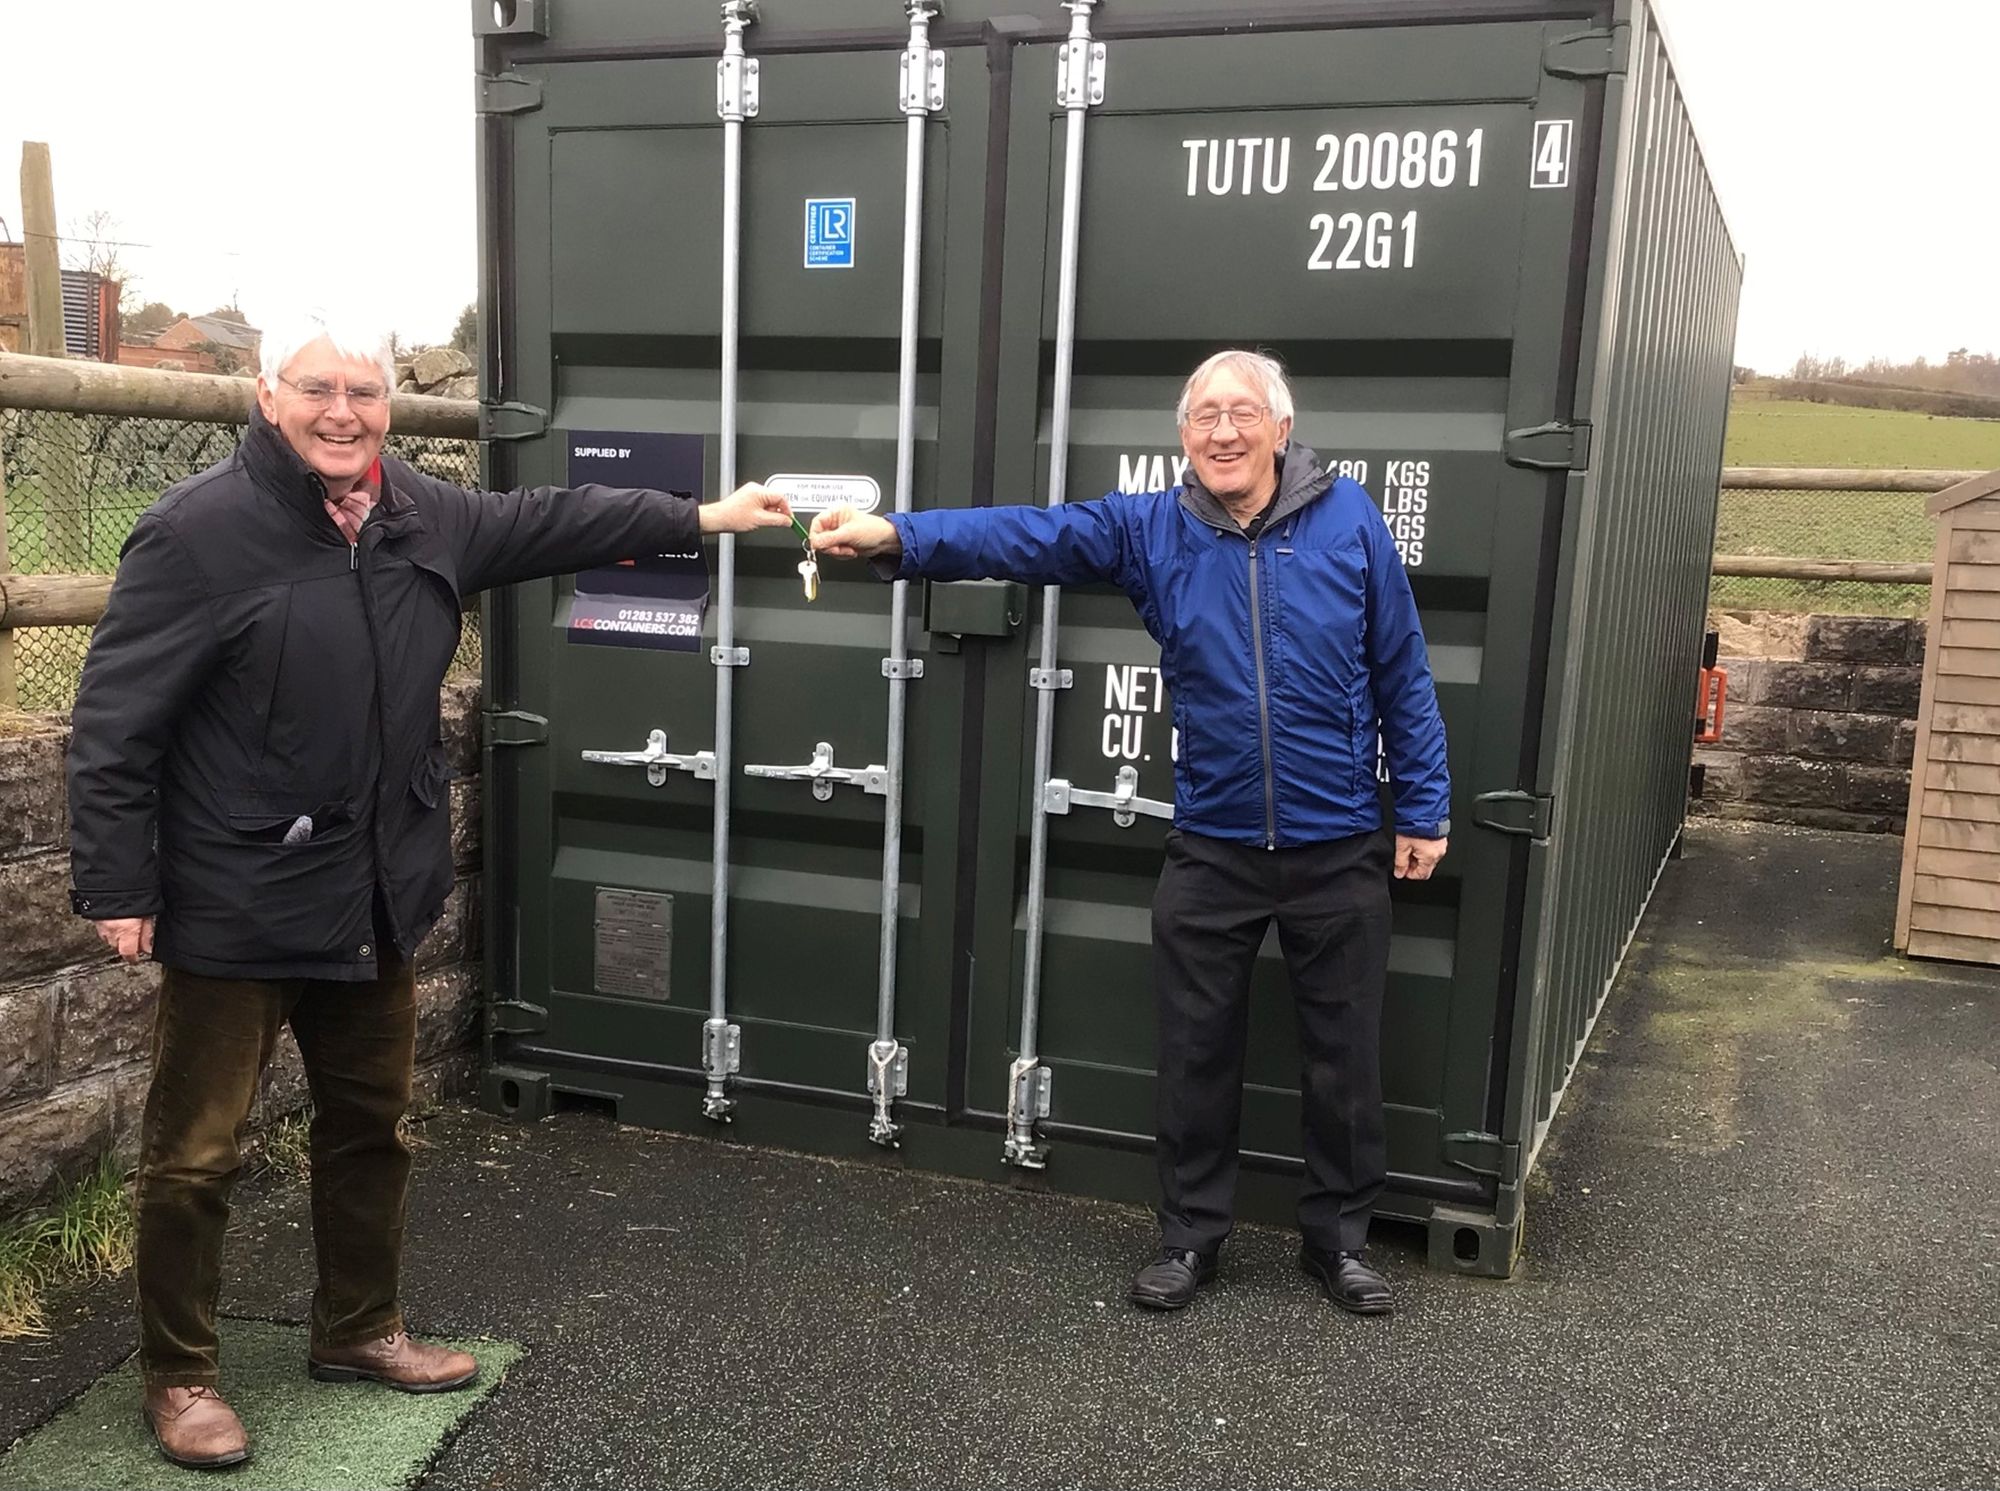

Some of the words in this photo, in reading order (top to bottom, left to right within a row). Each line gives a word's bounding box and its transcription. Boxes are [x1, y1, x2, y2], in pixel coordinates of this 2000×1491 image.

[1182, 137, 1291, 196] TUTU
[1313, 128, 1484, 191] 200861
[1536, 124, 1564, 184] 4
[824, 209, 846, 239] LR
[1307, 210, 1418, 271] 22G1
[574, 447, 617, 458] SUPPLIED
[618, 448, 631, 458] BY
[1385, 460, 1430, 487] KGS
[1383, 487, 1428, 513] LBS
[1382, 514, 1426, 540] KGS
[574, 618, 697, 636] LCSCONTAINERS.COM
[618, 609, 653, 621] 01283
[654, 611, 676, 623] 537
[678, 613, 700, 625] 382
[1104, 664, 1163, 713] NET
[1101, 713, 1151, 761] CU.
